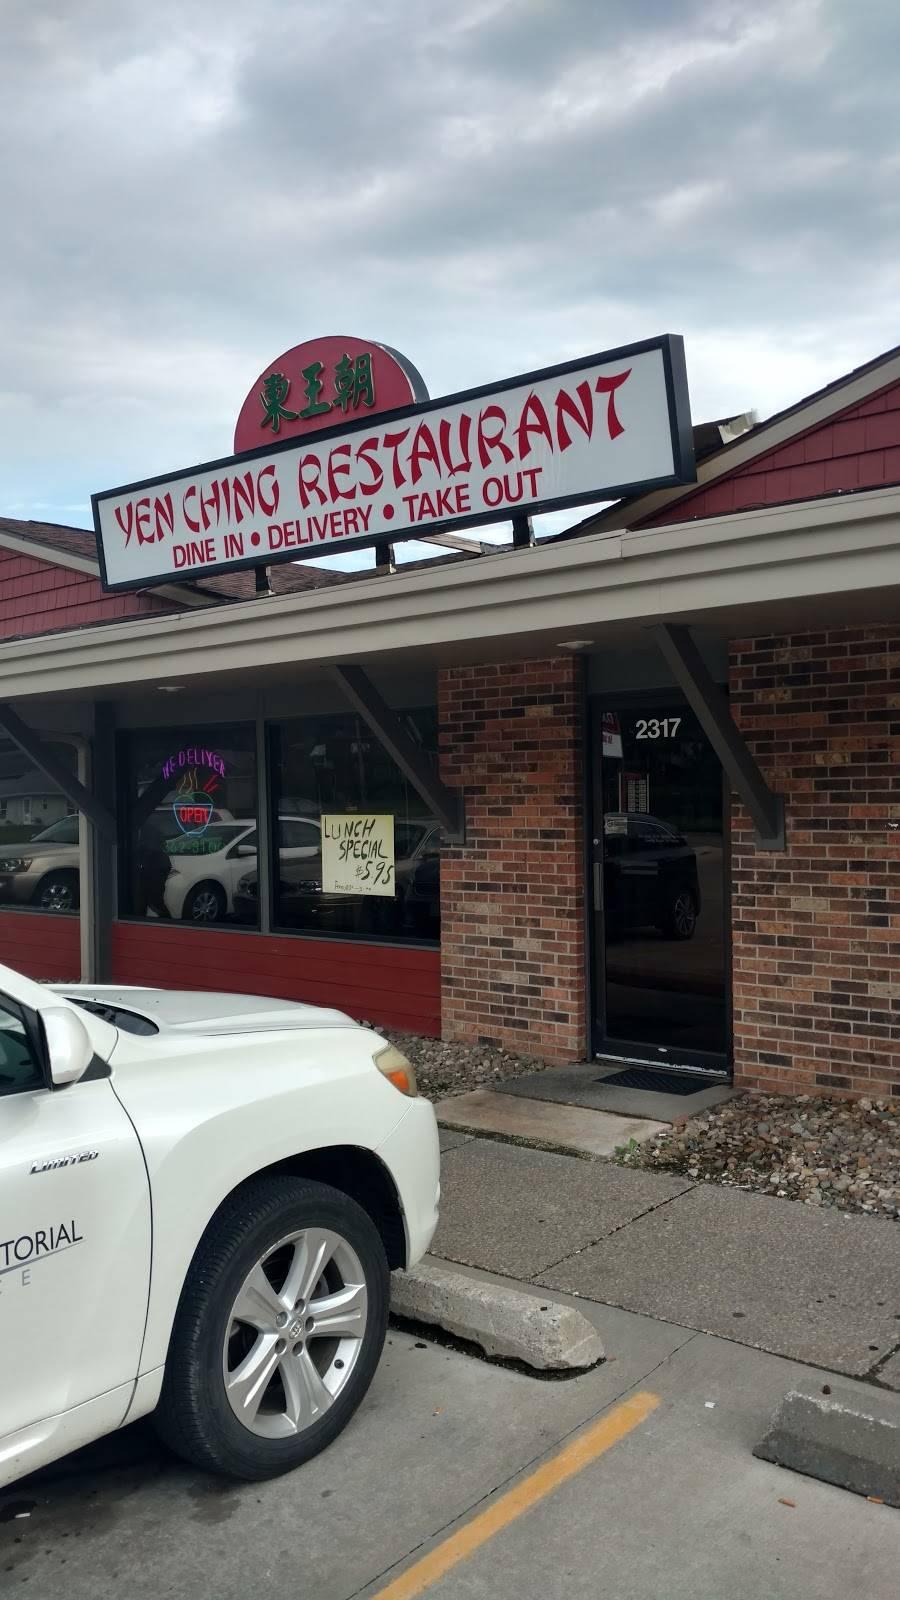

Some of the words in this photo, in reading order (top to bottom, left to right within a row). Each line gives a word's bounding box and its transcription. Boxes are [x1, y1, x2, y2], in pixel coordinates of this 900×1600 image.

[260, 352, 375, 433] 東王朝
[114, 491, 175, 548] YEN
[183, 464, 280, 533] CHING
[298, 367, 633, 509] RESTAURANT
[172, 538, 217, 569] DINE
[223, 532, 245, 558] IN
[267, 504, 373, 550] DELIVERY
[402, 483, 472, 522] TAKE
[482, 467, 543, 506] OUT
[635, 717, 681, 740] 2317
[180, 806, 209, 824] OPEN
[324, 816, 376, 840] LUNCH
[339, 839, 389, 862] SPECIAL
